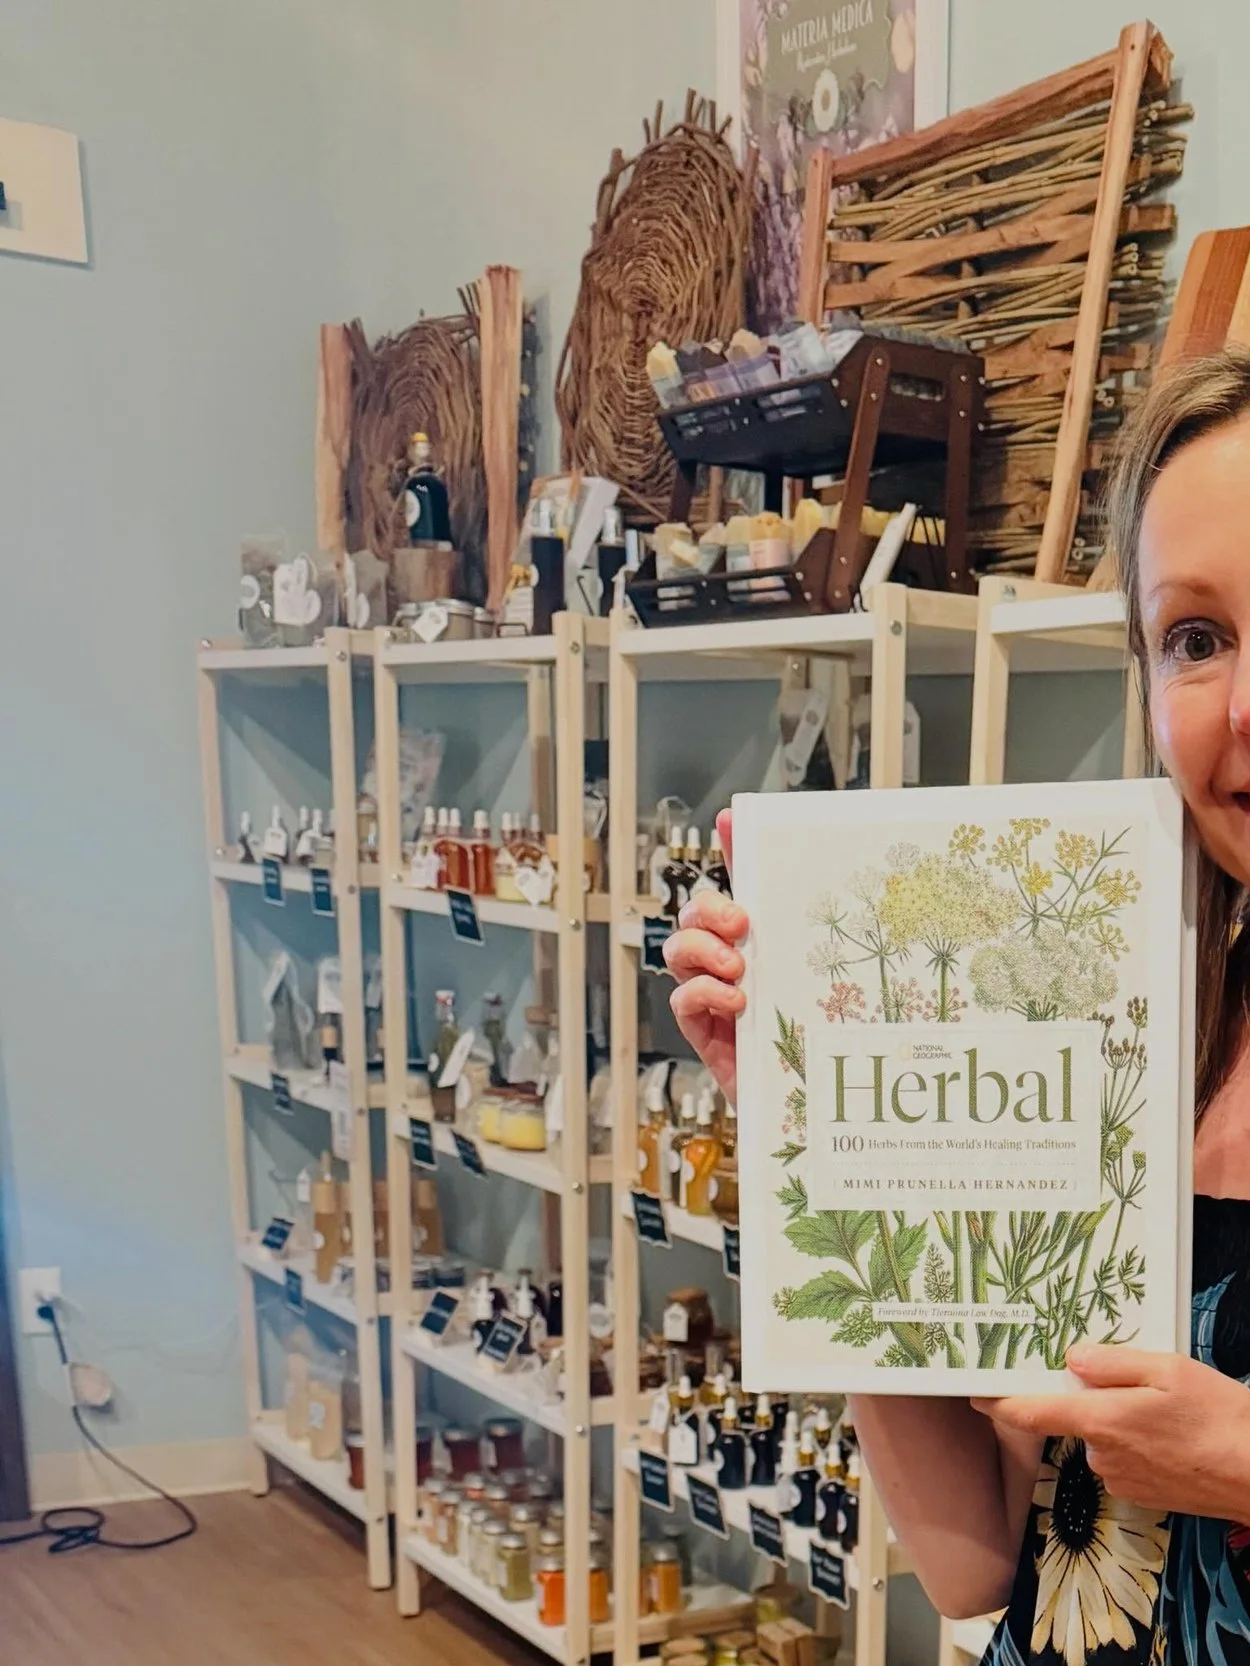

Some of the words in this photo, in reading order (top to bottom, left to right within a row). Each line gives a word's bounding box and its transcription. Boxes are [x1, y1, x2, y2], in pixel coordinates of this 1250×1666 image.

[781, 18, 828, 55] MATERIA
[832, 0, 874, 37] MEDICA
[912, 1044, 944, 1052] NATIONAL
[912, 1051, 953, 1060] GEOGRAPHIC
[826, 1046, 1080, 1124] Herbal
[831, 1134, 865, 1153] 100
[868, 1139, 898, 1150] Herbs
[900, 1139, 926, 1150] From
[927, 1139, 943, 1150] the
[945, 1139, 982, 1150] World's
[984, 1139, 1022, 1151] Healing
[1025, 1139, 1077, 1150] Traditions
[843, 1179, 881, 1190] MIMI
[887, 1179, 967, 1190] PRUNELLA
[973, 1179, 1069, 1190] HERNANDEZ
[877, 1307, 919, 1317] Foreword
[918, 1308, 929, 1319] by
[1010, 1309, 1030, 1319] M.D.
